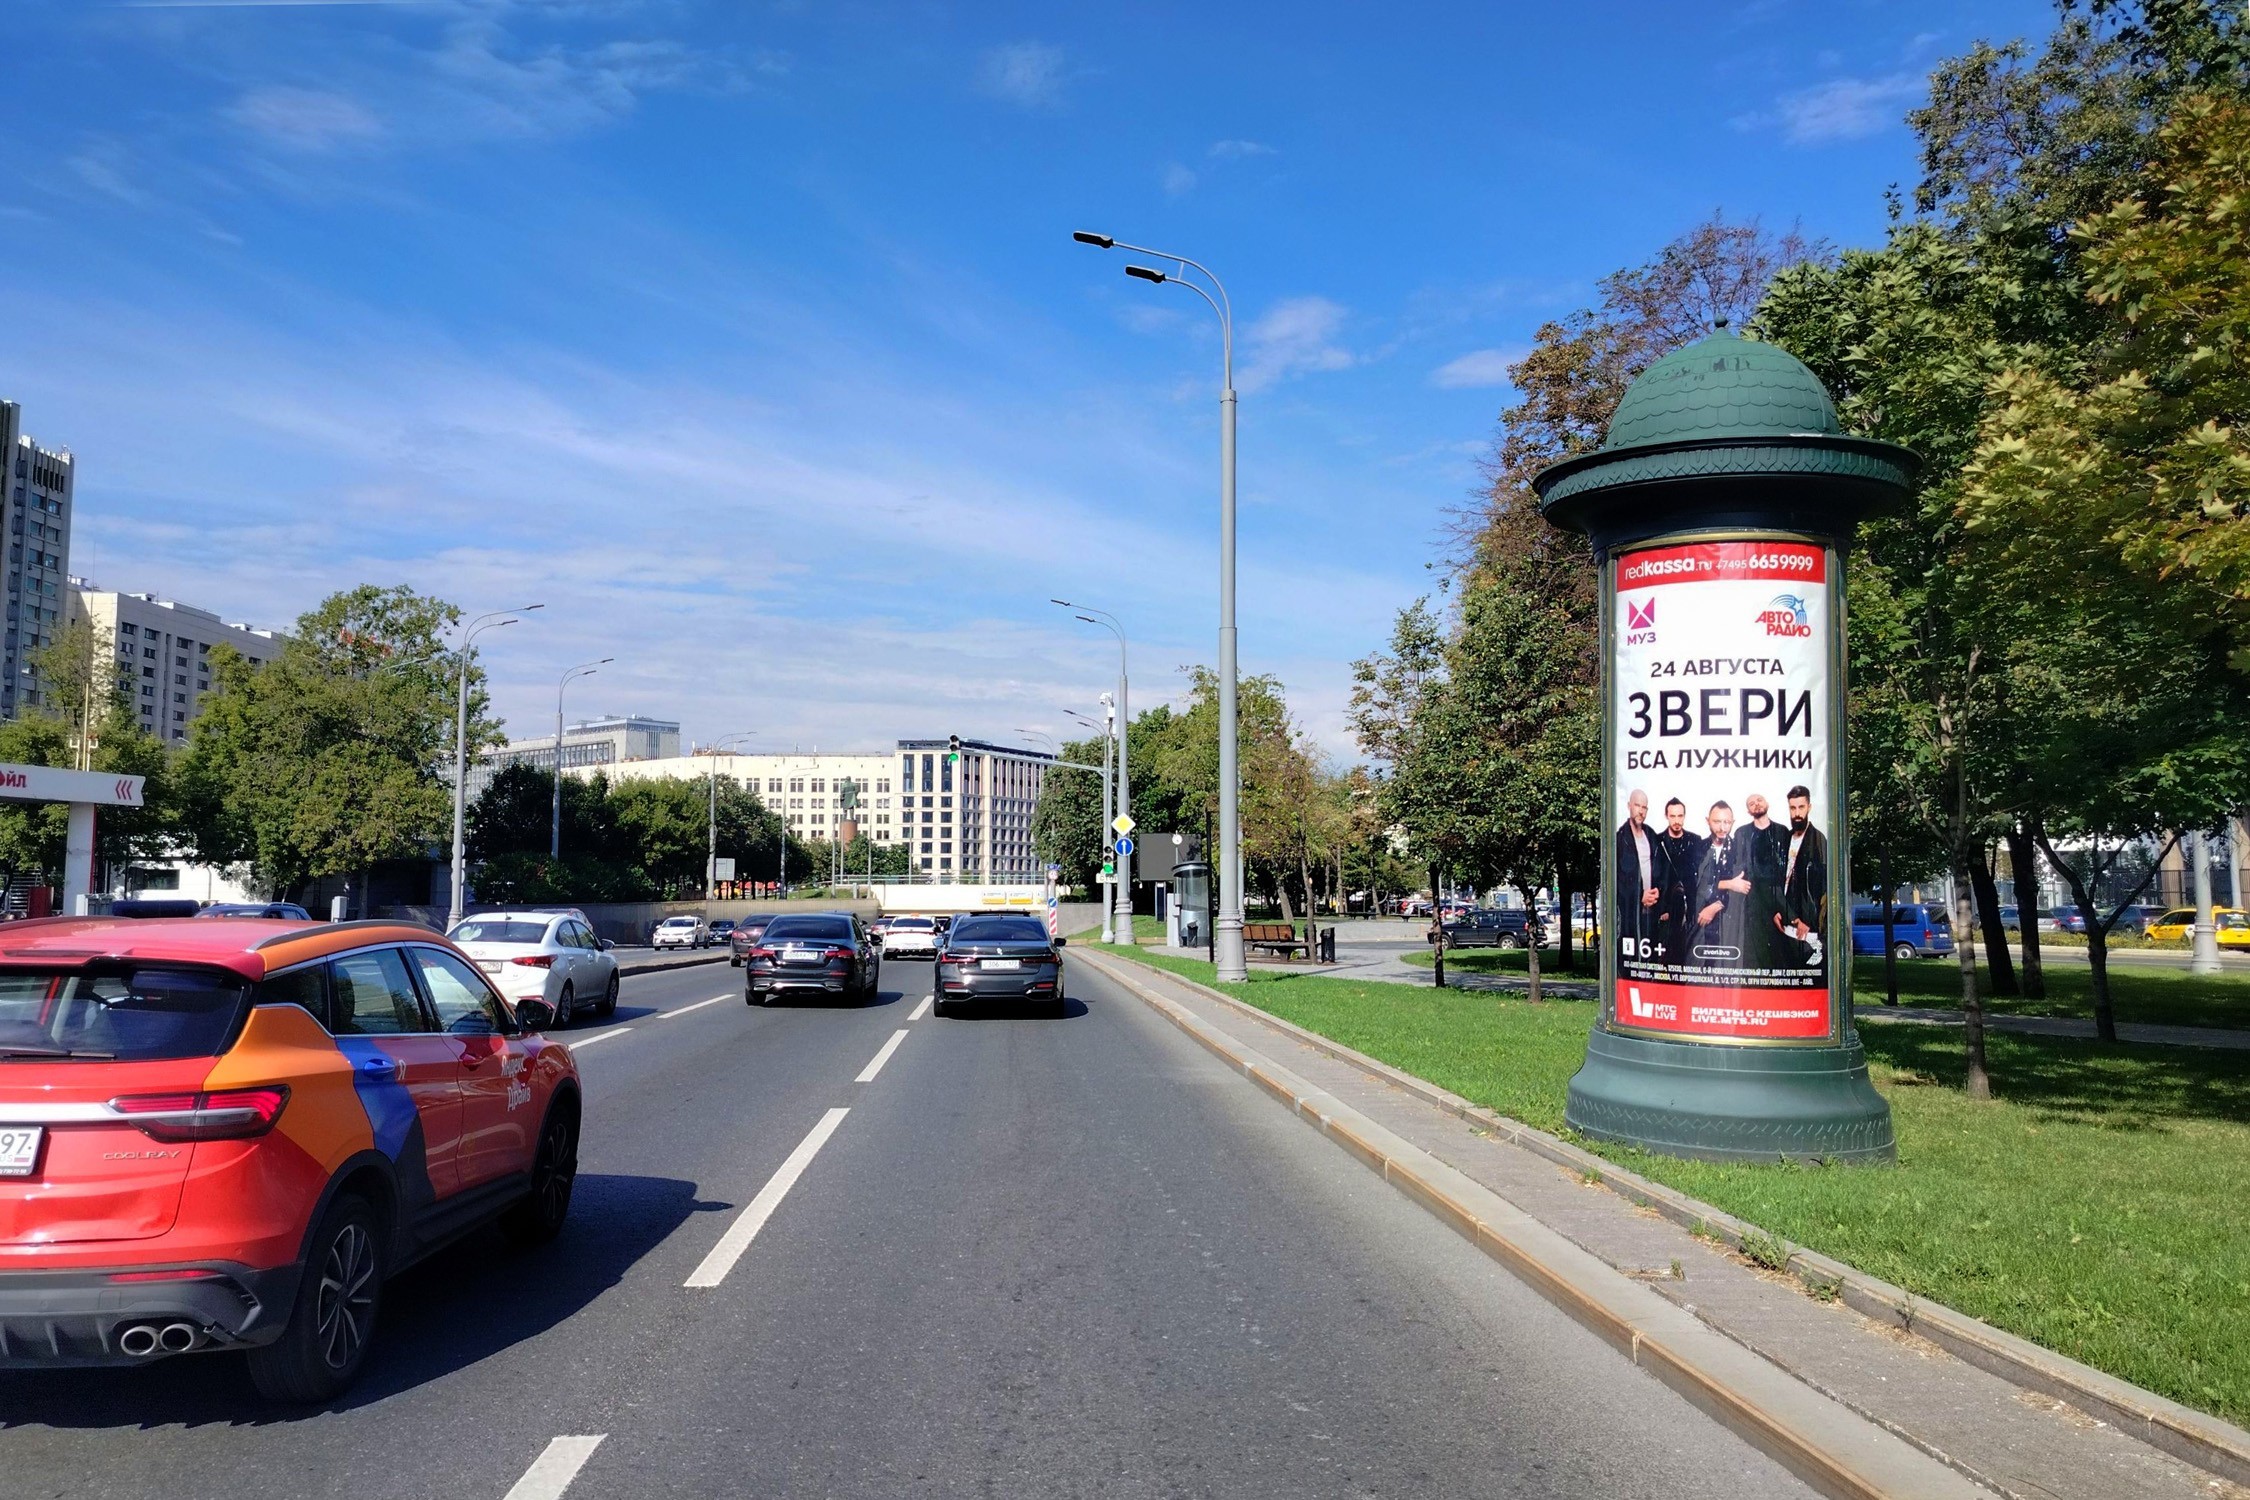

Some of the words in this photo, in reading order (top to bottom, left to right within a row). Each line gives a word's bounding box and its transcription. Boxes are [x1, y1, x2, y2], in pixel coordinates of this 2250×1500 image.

[1625, 557, 1712, 580] redkassa.ru
[1748, 553, 1814, 571] 6659999
[1755, 610, 1794, 624] АВТО
[1766, 623, 1811, 637] РАДИО
[1627, 632, 1656, 646] МУЗ
[1650, 660, 1676, 678] 24
[1682, 658, 1785, 676] АВГУСТА
[1628, 687, 1812, 740] ЗВЕРИ
[1627, 750, 1668, 770] БСА
[1675, 748, 1812, 770] ЛУЖНИКИ
[1640, 937, 1667, 958] 6+
[1654, 1003, 1677, 1013] МТС
[1654, 1012, 1677, 1021] LIVE
[1691, 1006, 1743, 1017] БИЛЕТЫ
[1745, 1009, 1755, 1018] С
[1756, 1009, 1819, 1019] КЕШБЭКОМ
[1691, 1015, 1768, 1026] LIVE.MTS.RU
[397, 1059, 407, 1081] Я
[501, 1054, 528, 1078] Яндекс
[507, 1082, 531, 1112] Драйв
[103, 1150, 182, 1161] COOLRAY
